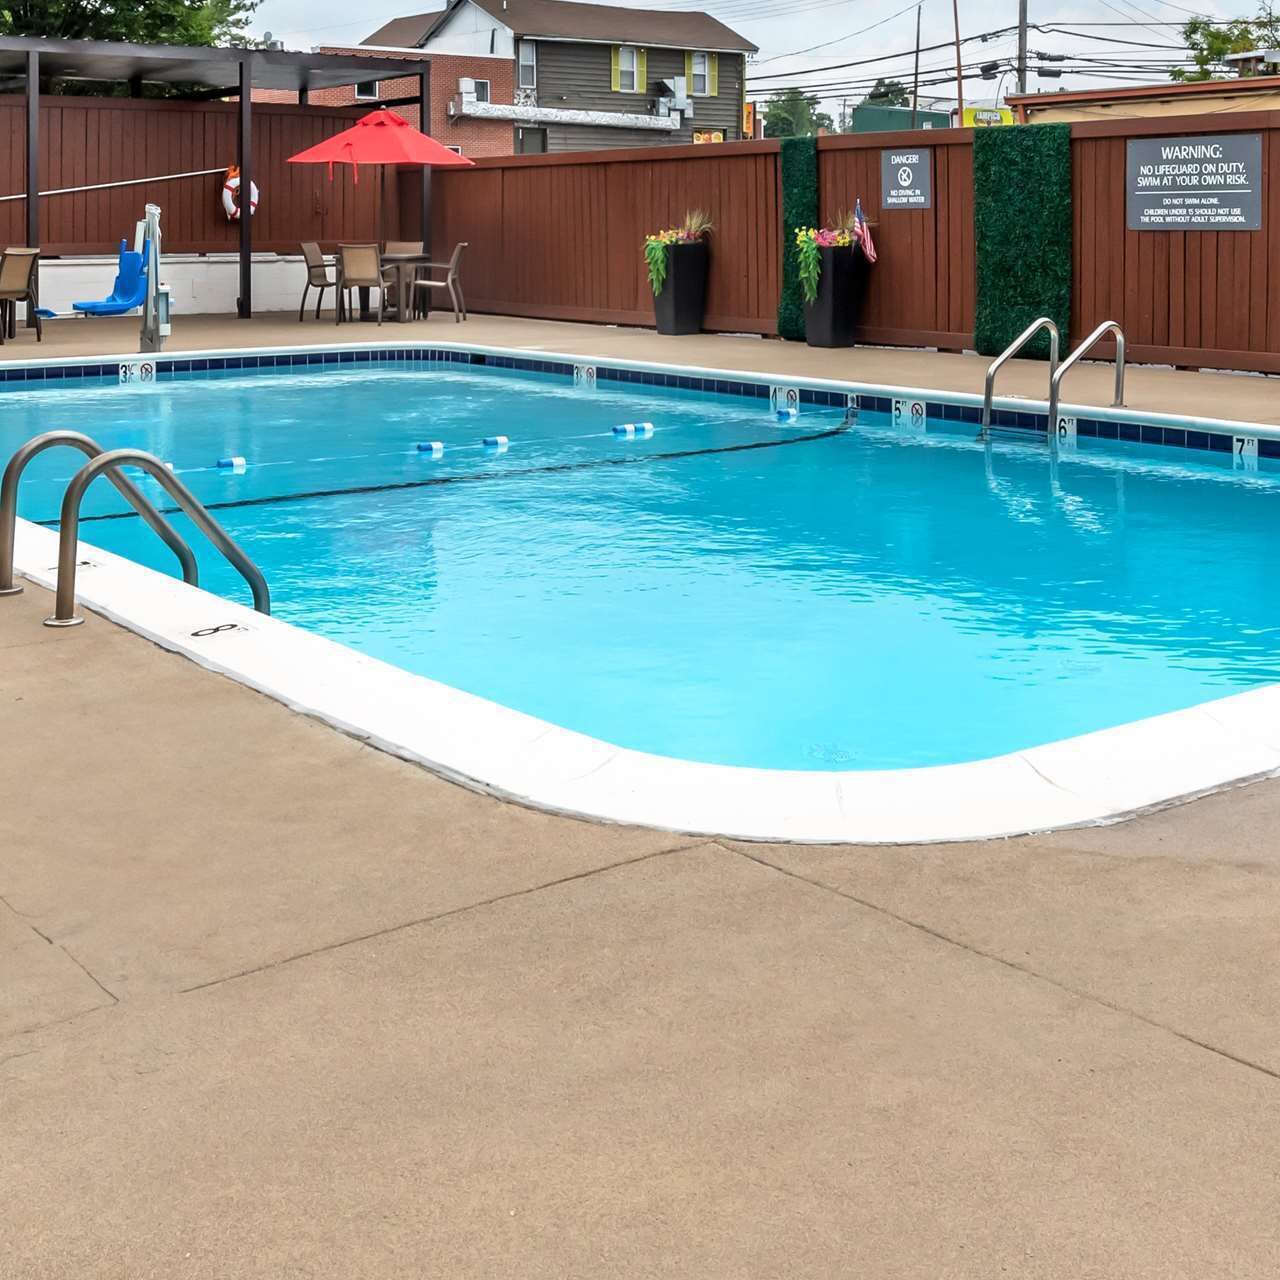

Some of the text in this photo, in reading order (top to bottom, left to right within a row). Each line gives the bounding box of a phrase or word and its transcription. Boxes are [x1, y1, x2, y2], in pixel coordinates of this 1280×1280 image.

[891, 154, 919, 164] DANGER!
[1161, 145, 1222, 160] WARNING:
[1140, 162, 1246, 175] NO LIFEGUARD ON DUTY.
[1137, 174, 1249, 187] SWIM AT YOUR OWN RISK.
[1184, 197, 1200, 205] SWIM
[1144, 208, 1168, 216] CHILDREN
[1209, 215, 1246, 223] SUPERVISION.
[894, 400, 902, 418] 5
[1059, 418, 1067, 438] 6
[1235, 437, 1255, 455] 7 FT
[190, 623, 238, 637] 8
